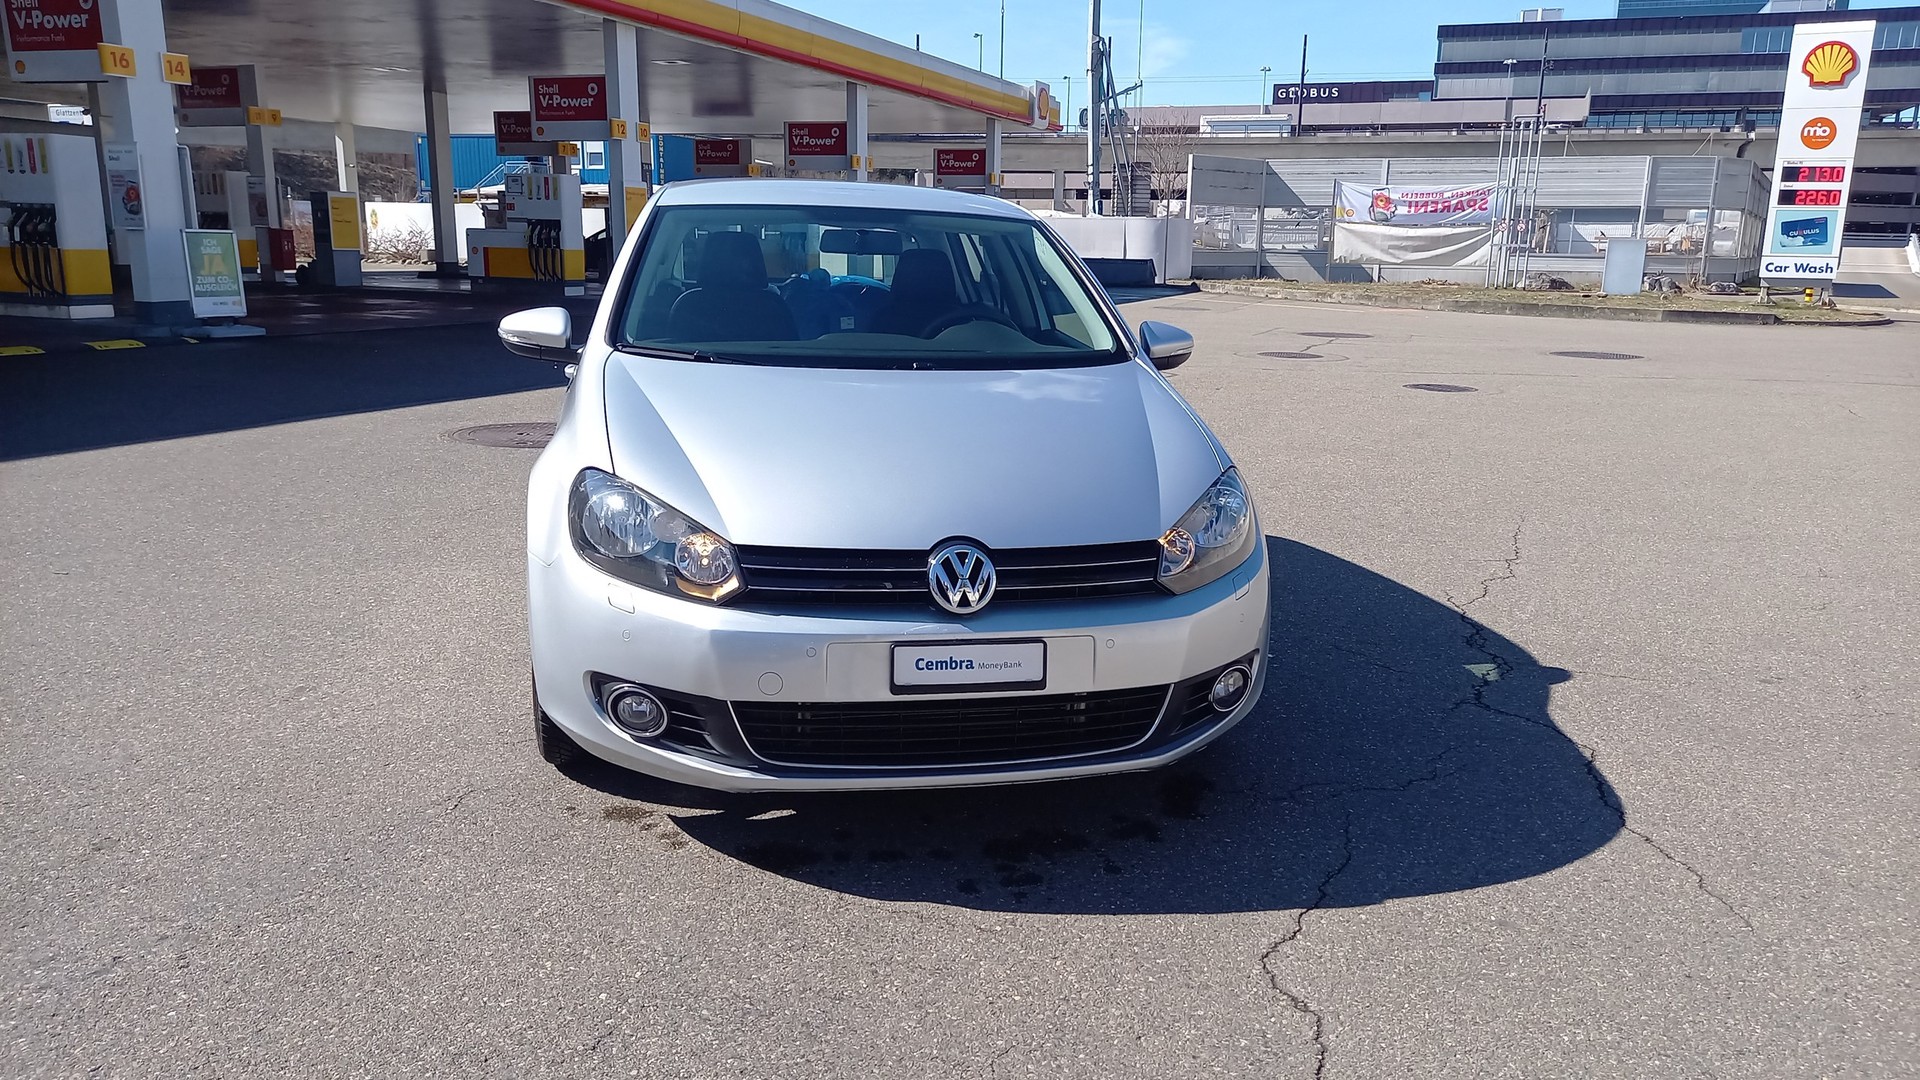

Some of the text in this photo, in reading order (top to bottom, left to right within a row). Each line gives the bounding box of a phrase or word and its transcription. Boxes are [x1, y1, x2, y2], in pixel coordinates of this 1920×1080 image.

[13, 10, 89, 30] V-Power
[110, 51, 130, 69] 16
[166, 60, 186, 76] 14
[183, 85, 228, 96] V-Power
[538, 84, 559, 94] Shell
[1277, 87, 1339, 98] GLOBUS
[540, 95, 594, 107] V-Power
[55, 109, 84, 117] Glattzent
[501, 125, 532, 133] V-Pow
[616, 123, 626, 135] 12
[640, 127, 648, 138] 10
[791, 128, 809, 136] Shell
[1803, 122, 1831, 137] mio
[792, 135, 837, 146] V-Power
[698, 149, 731, 157] V-Power
[940, 160, 976, 168] V-Power
[1795, 190, 1841, 205] 226.0
[1765, 262, 1833, 274] Car Wash
[196, 275, 217, 284] ZUM
[915, 656, 1023, 671] Cembra MoneyBank
